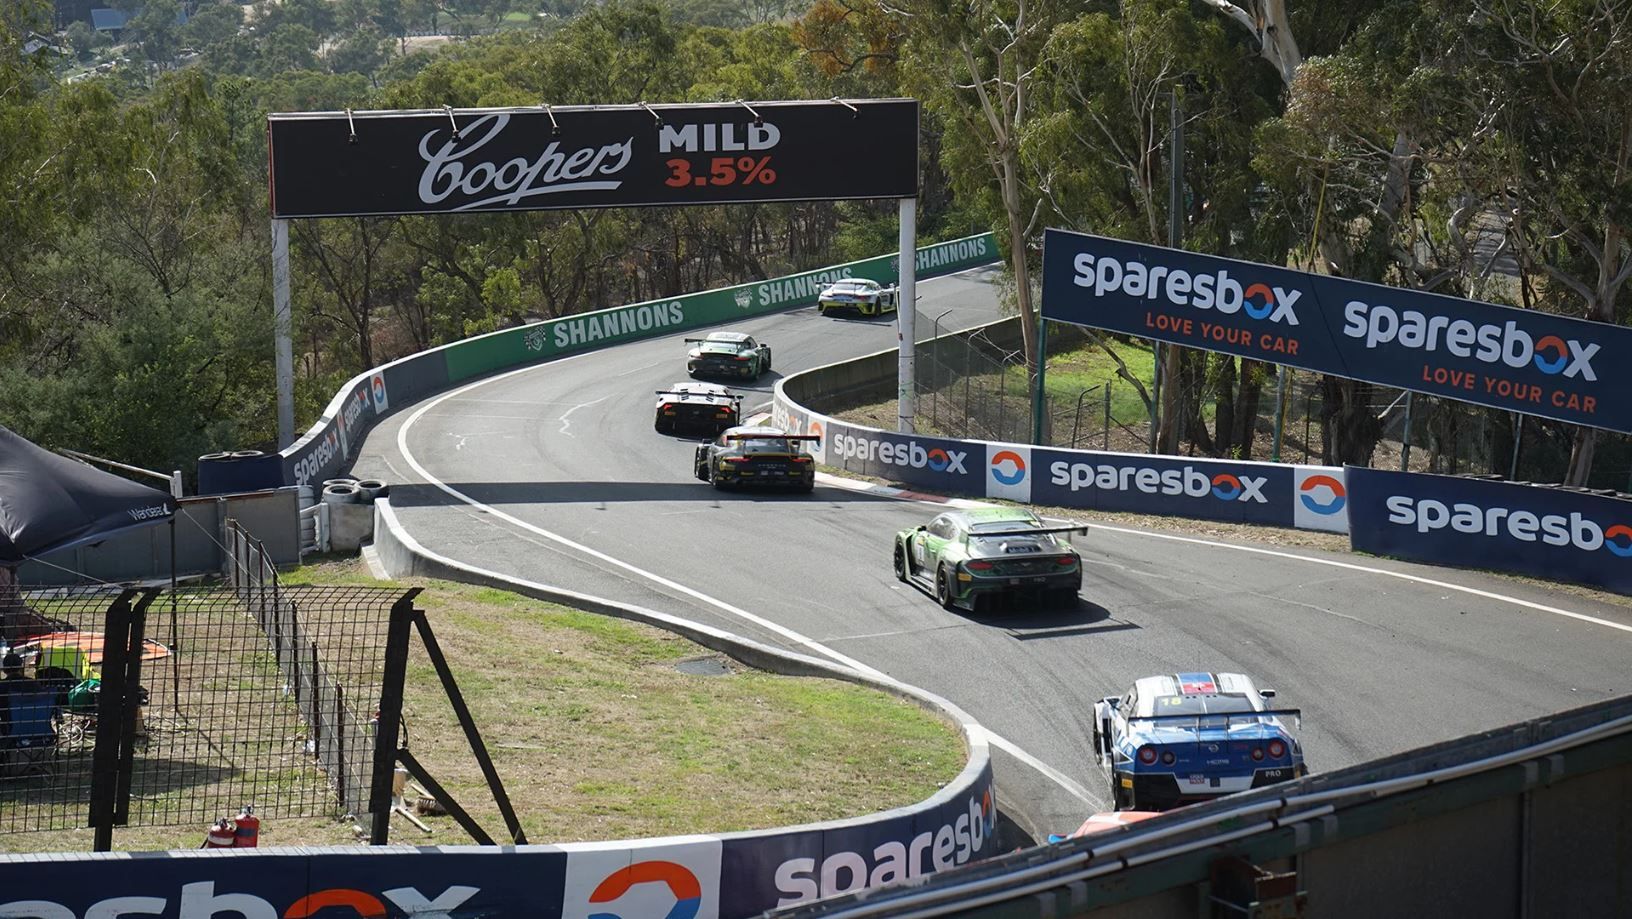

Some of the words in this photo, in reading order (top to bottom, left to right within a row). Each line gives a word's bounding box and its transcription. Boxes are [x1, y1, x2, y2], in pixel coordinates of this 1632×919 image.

[418, 113, 634, 208] Coopers
[659, 122, 781, 153] MILD
[665, 156, 777, 188] 3.5%
[1073, 253, 1302, 326] sparesbox
[553, 300, 684, 348] SHANNONS
[1146, 312, 1193, 335] LOVE
[1200, 322, 1252, 346] YOUR
[1260, 334, 1300, 356] CAR
[1343, 300, 1601, 381] sparesbox
[1423, 365, 1476, 390] LOVE
[1484, 376, 1543, 403] YOUR
[1551, 390, 1597, 414] CAR
[294, 428, 340, 486] sparesbox
[833, 433, 968, 475] sparesbox
[1050, 461, 1269, 504] sparesbox
[1161, 696, 1182, 707] 18
[1265, 769, 1282, 778] PRO
[774, 784, 998, 910] sparesbox
